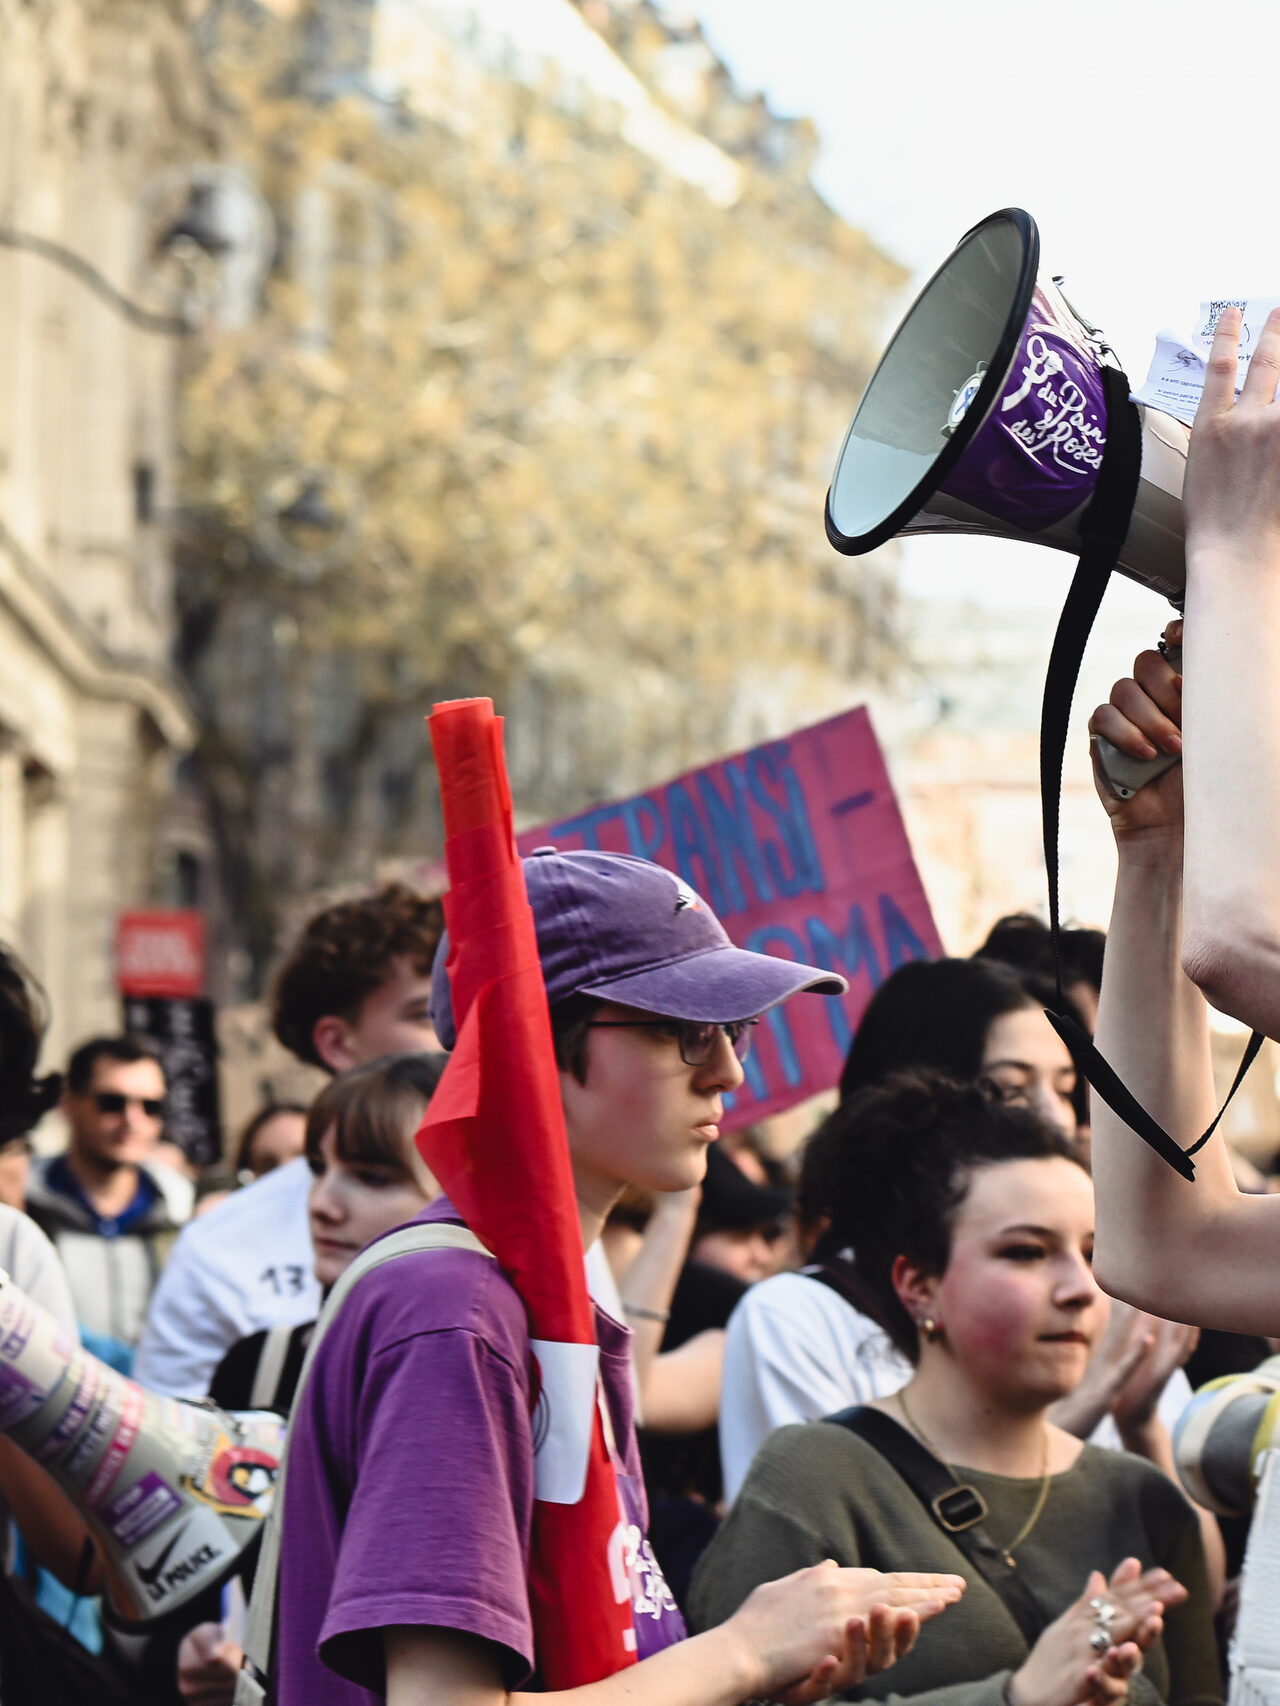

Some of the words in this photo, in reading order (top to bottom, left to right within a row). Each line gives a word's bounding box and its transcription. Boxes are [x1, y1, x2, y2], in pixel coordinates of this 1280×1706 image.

[1037, 381, 1058, 408] du
[1039, 380, 1107, 444] Pain
[1011, 419, 1036, 445] des
[1030, 421, 1104, 475] Roses
